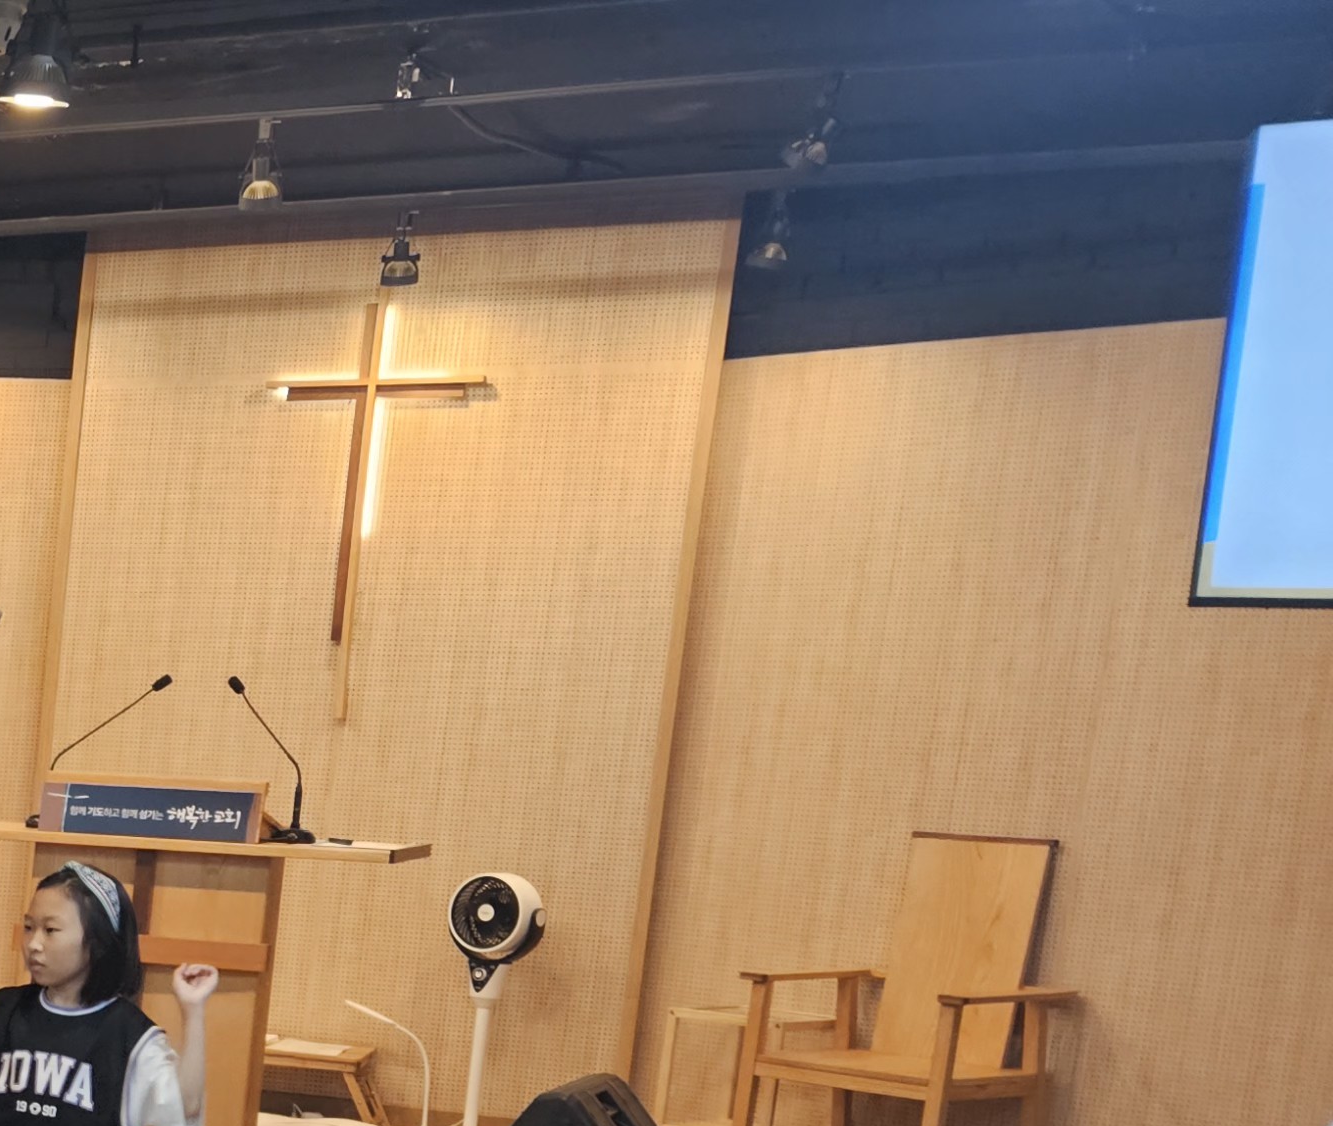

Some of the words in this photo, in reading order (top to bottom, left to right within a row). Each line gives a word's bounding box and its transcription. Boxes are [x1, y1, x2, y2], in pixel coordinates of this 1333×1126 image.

[87, 806, 120, 818] 기도하고
[139, 808, 164, 821] 섬기는
[166, 804, 212, 830] 행복한
[213, 807, 241, 830] 교회
[16, 1100, 27, 1113] 19
[41, 1105, 57, 1118] 90
